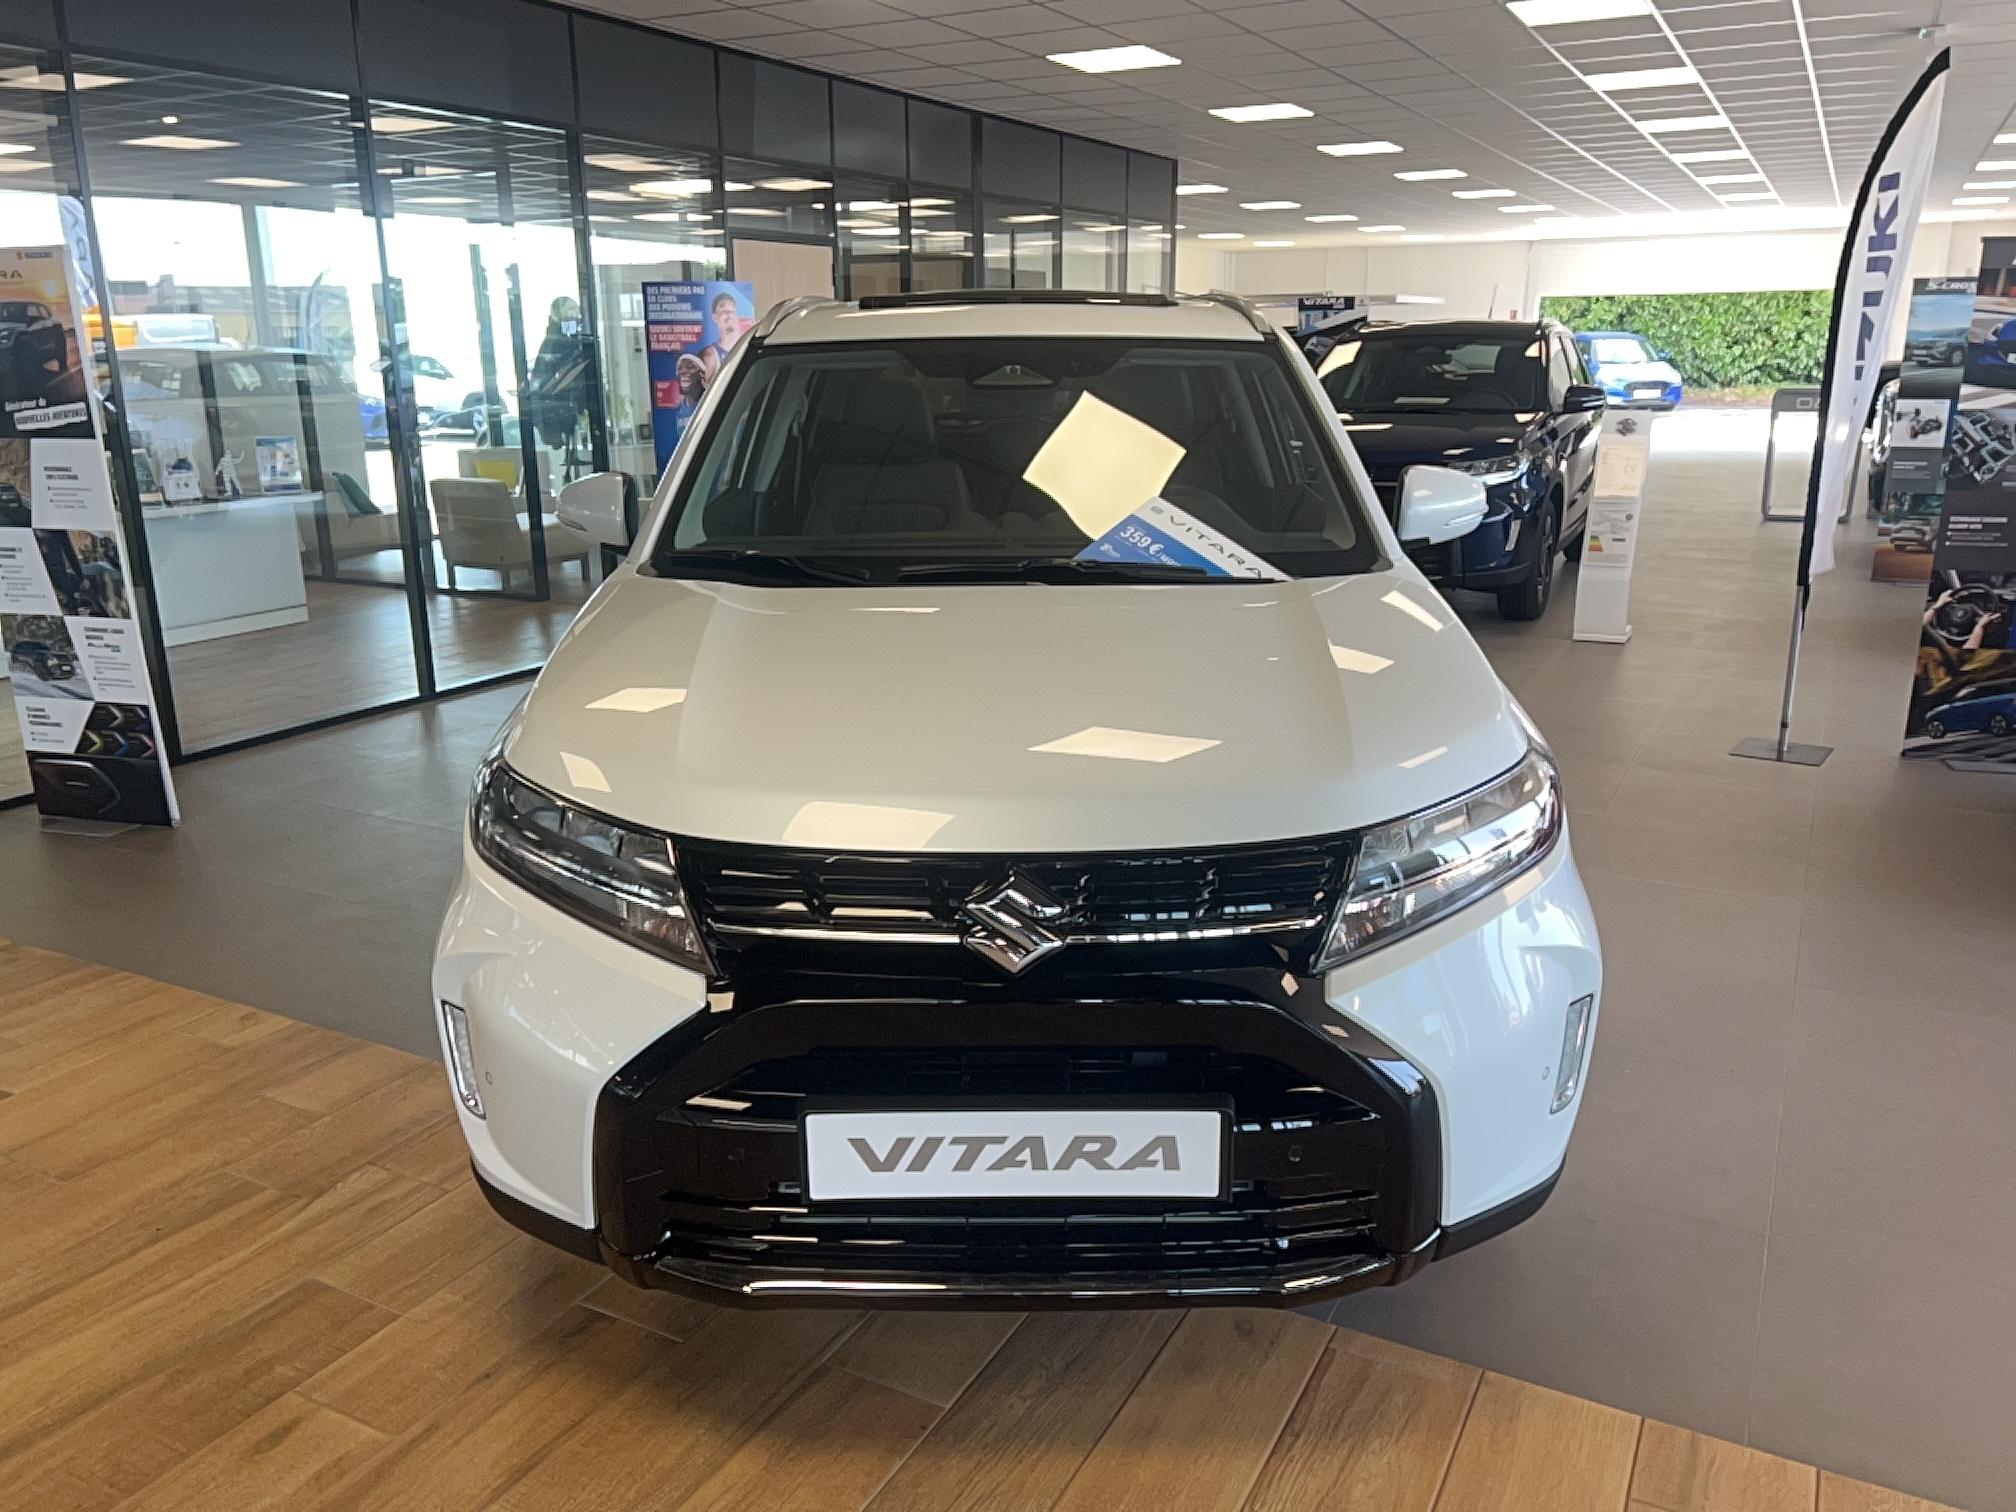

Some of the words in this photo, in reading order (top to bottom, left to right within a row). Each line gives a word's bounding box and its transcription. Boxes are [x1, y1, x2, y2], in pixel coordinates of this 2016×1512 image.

[1853, 173, 1901, 405] ZUKI
[1120, 526, 1152, 548] 359
[1169, 515, 1262, 579] VITARA
[847, 1135, 1181, 1172] VITARA
